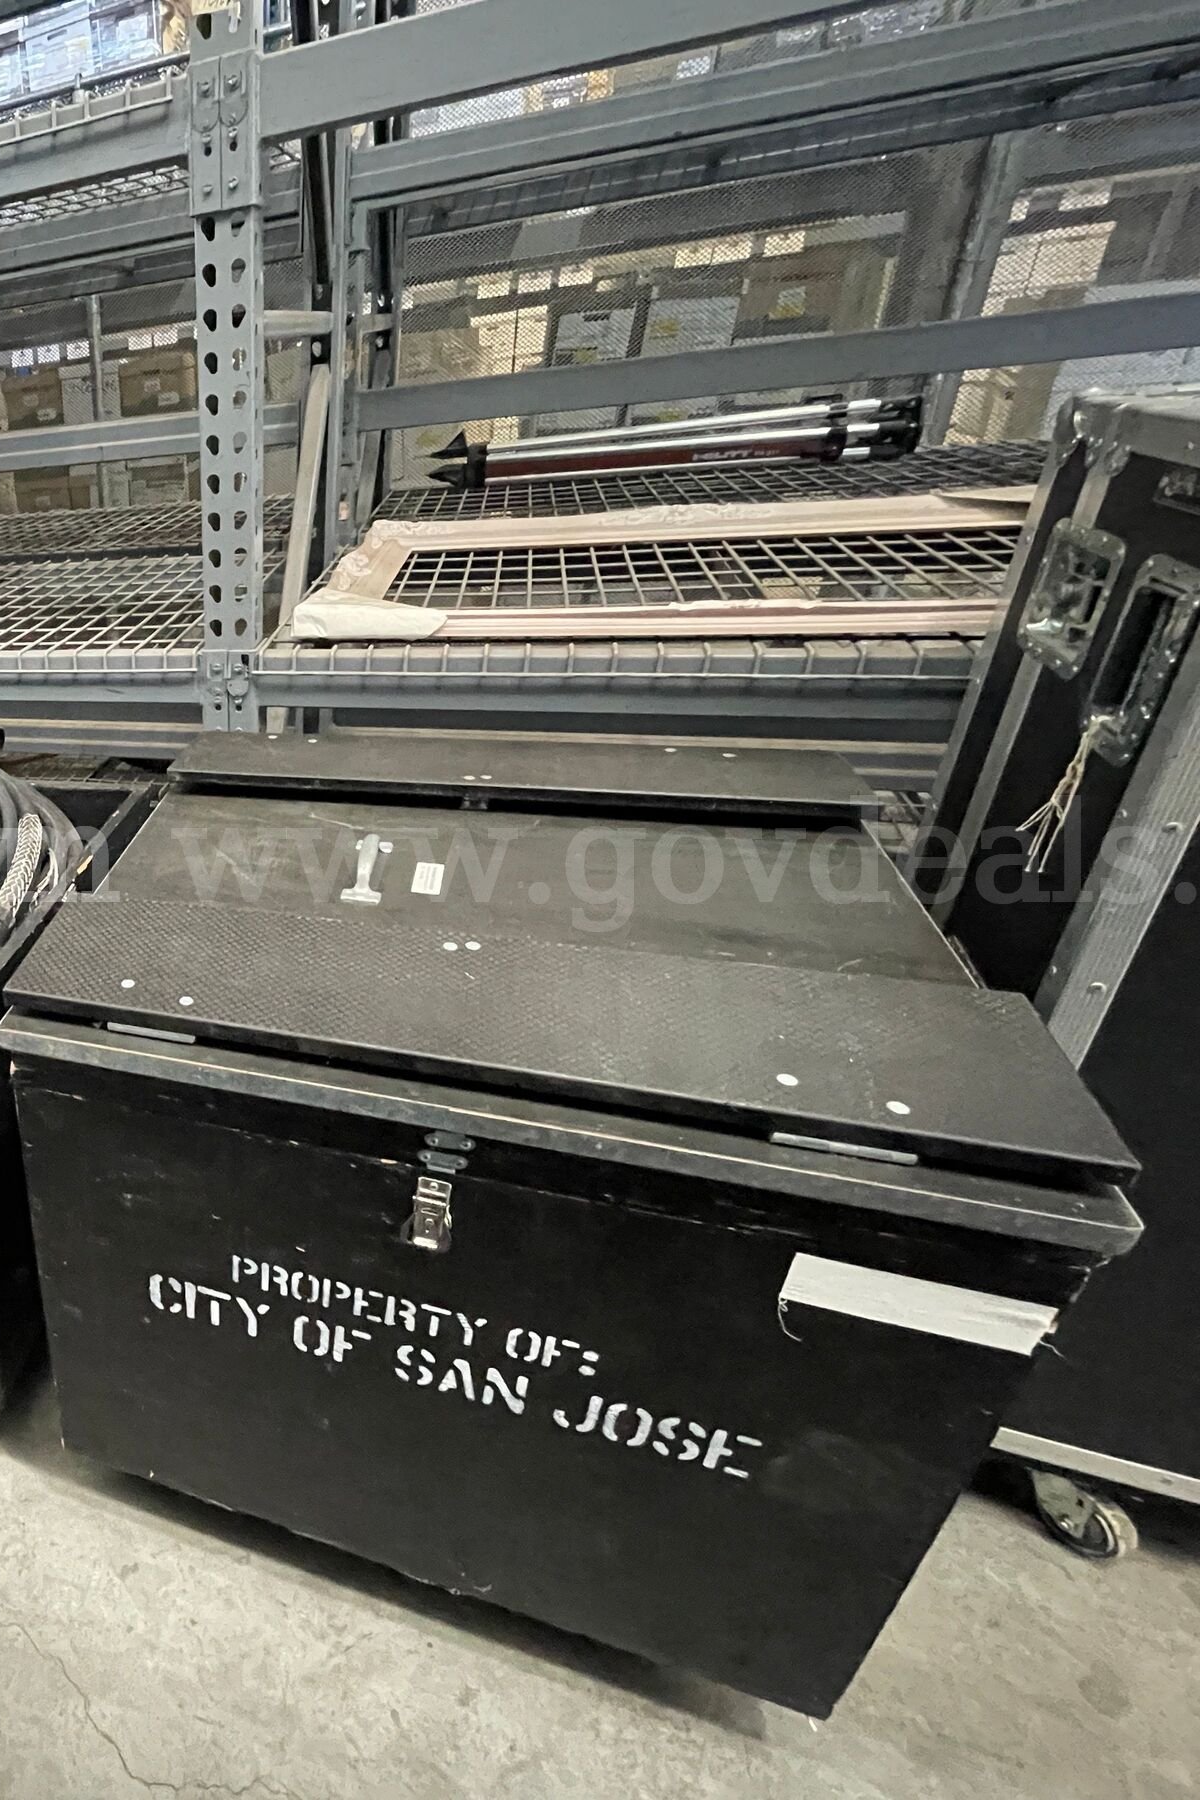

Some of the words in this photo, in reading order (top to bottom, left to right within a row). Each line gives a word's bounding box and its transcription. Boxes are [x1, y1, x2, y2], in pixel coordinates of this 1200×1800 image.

[149, 1273, 270, 1338] CITY
[293, 1314, 372, 1363] OF
[395, 1343, 530, 1415] SAN
[552, 1395, 763, 1479] JOSE
[232, 1254, 488, 1346] PROPERTY
[505, 1327, 600, 1376] OF:
